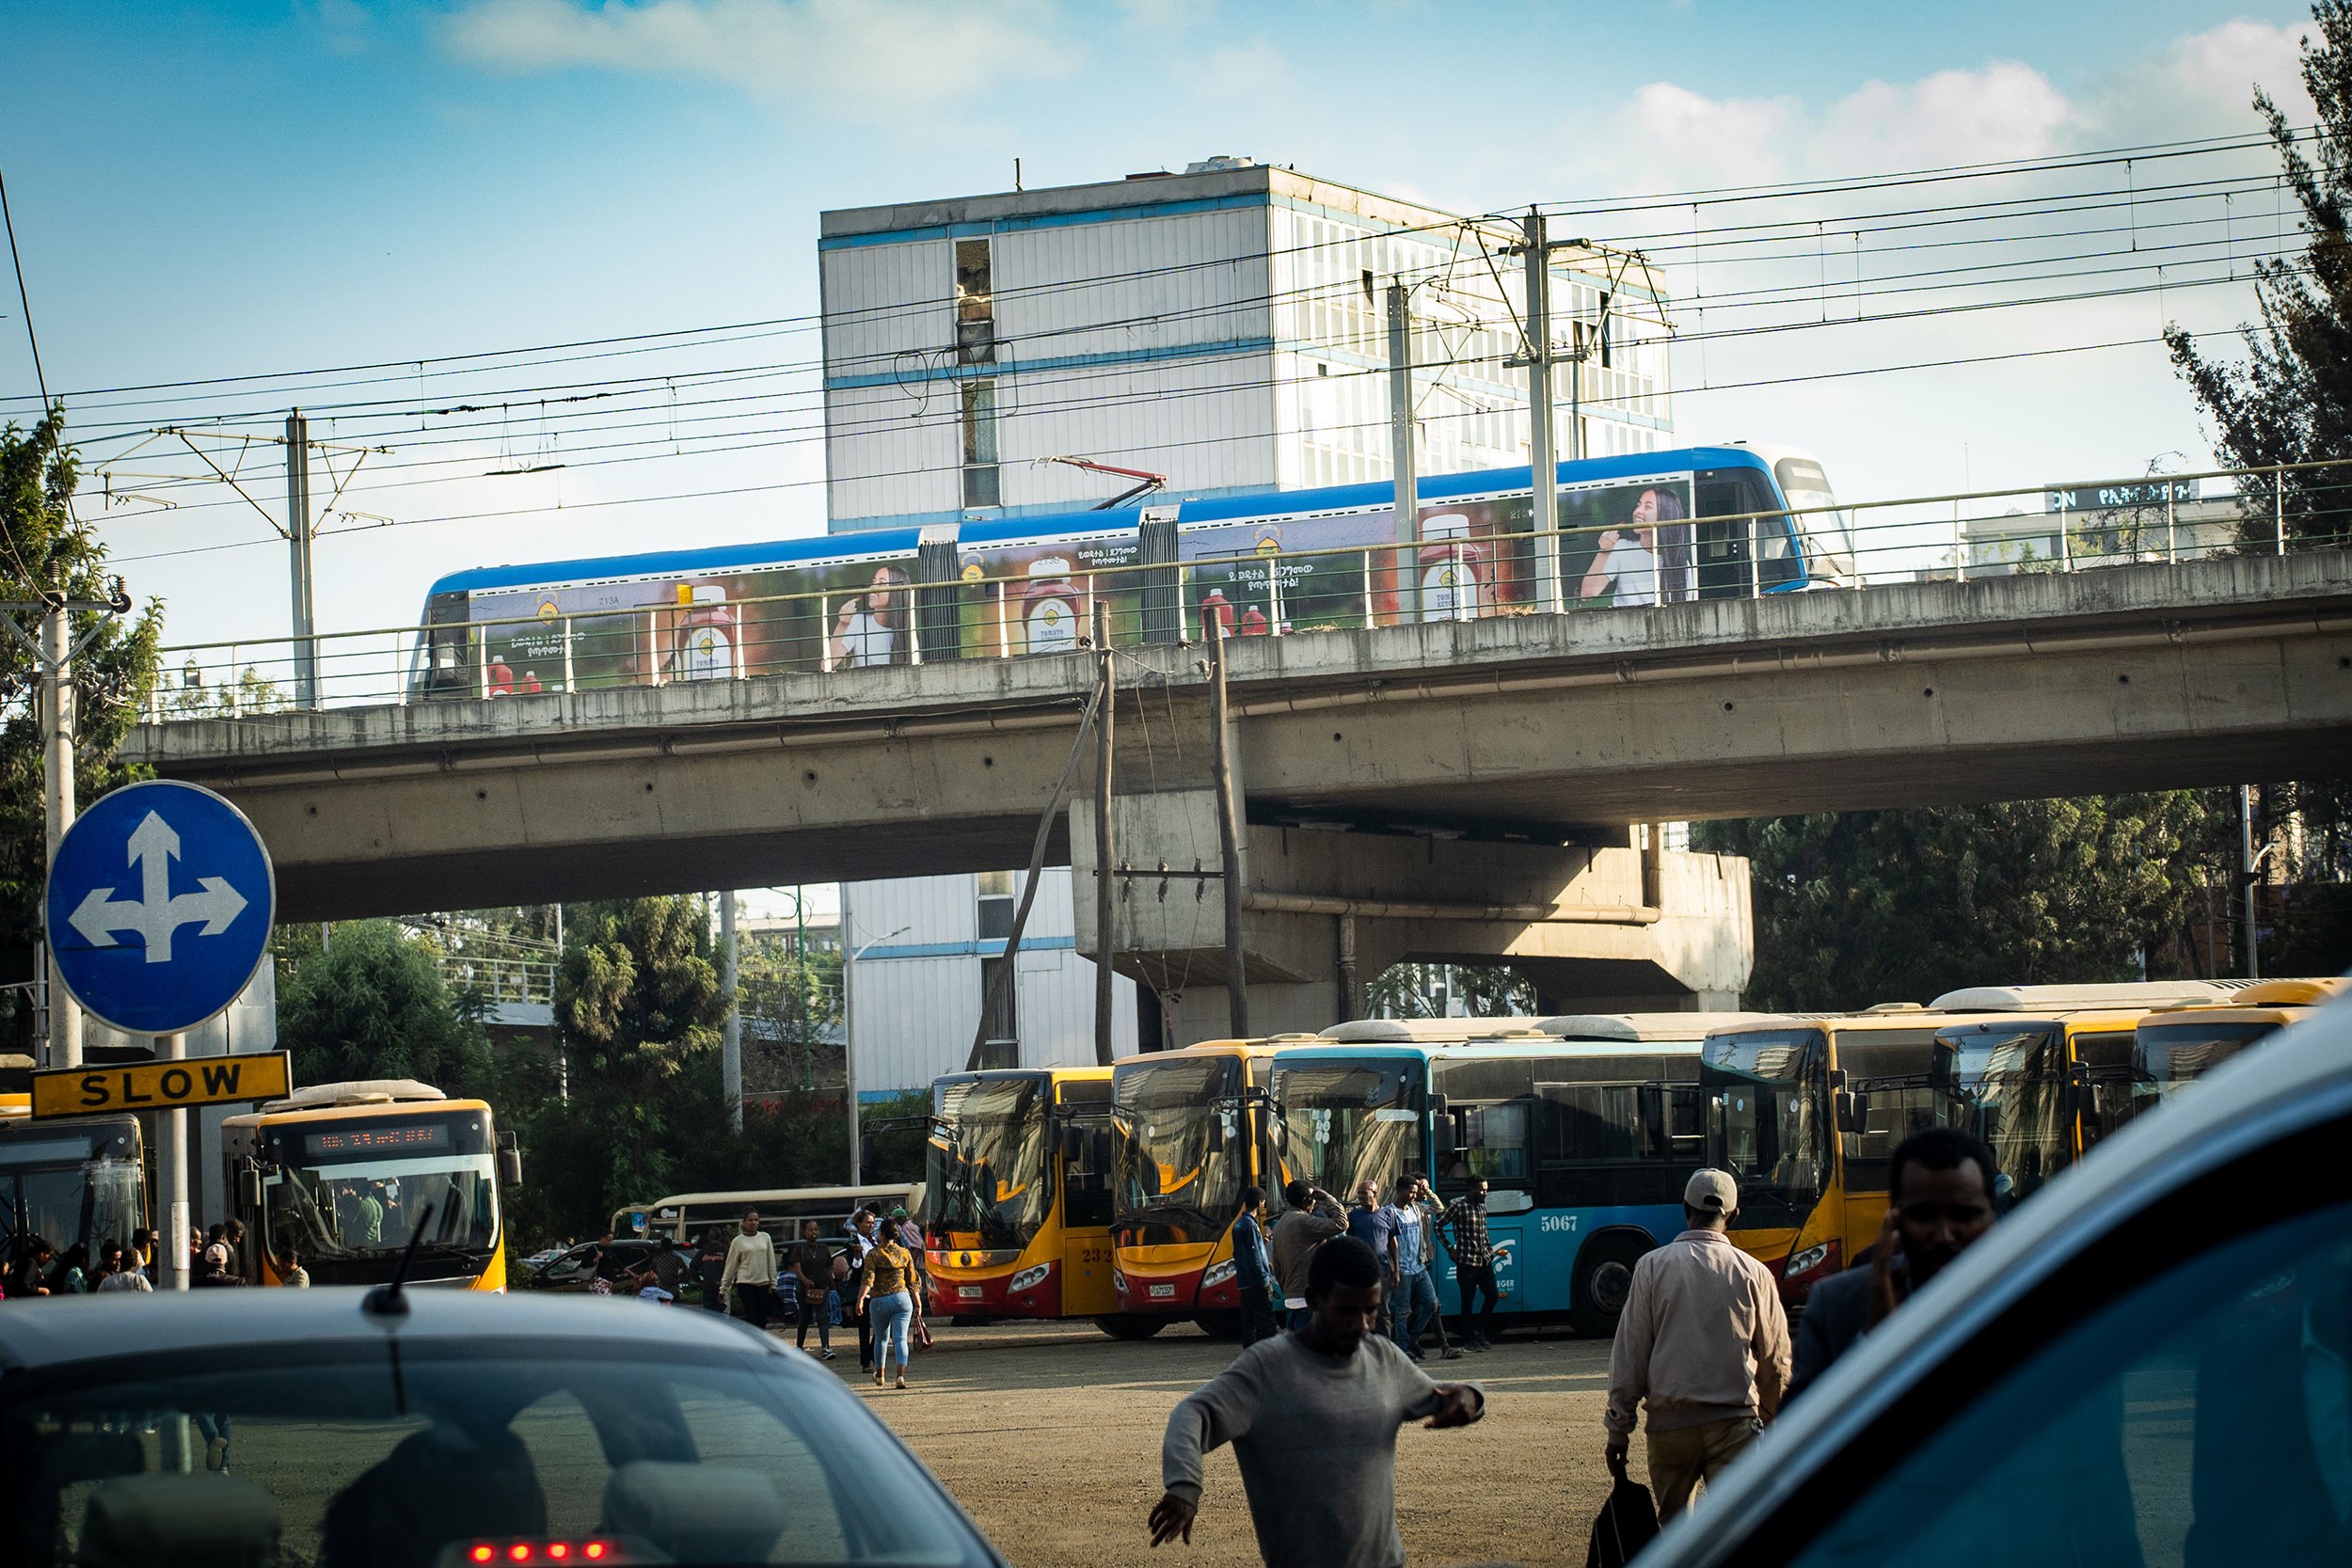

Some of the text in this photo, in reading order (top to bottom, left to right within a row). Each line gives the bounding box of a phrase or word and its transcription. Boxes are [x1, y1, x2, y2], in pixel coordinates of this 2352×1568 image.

[599, 595, 619, 605] 213A
[80, 1064, 241, 1106] SLOW
[1541, 1215, 1578, 1231] 5067
[1497, 1279, 1515, 1288] EGER
